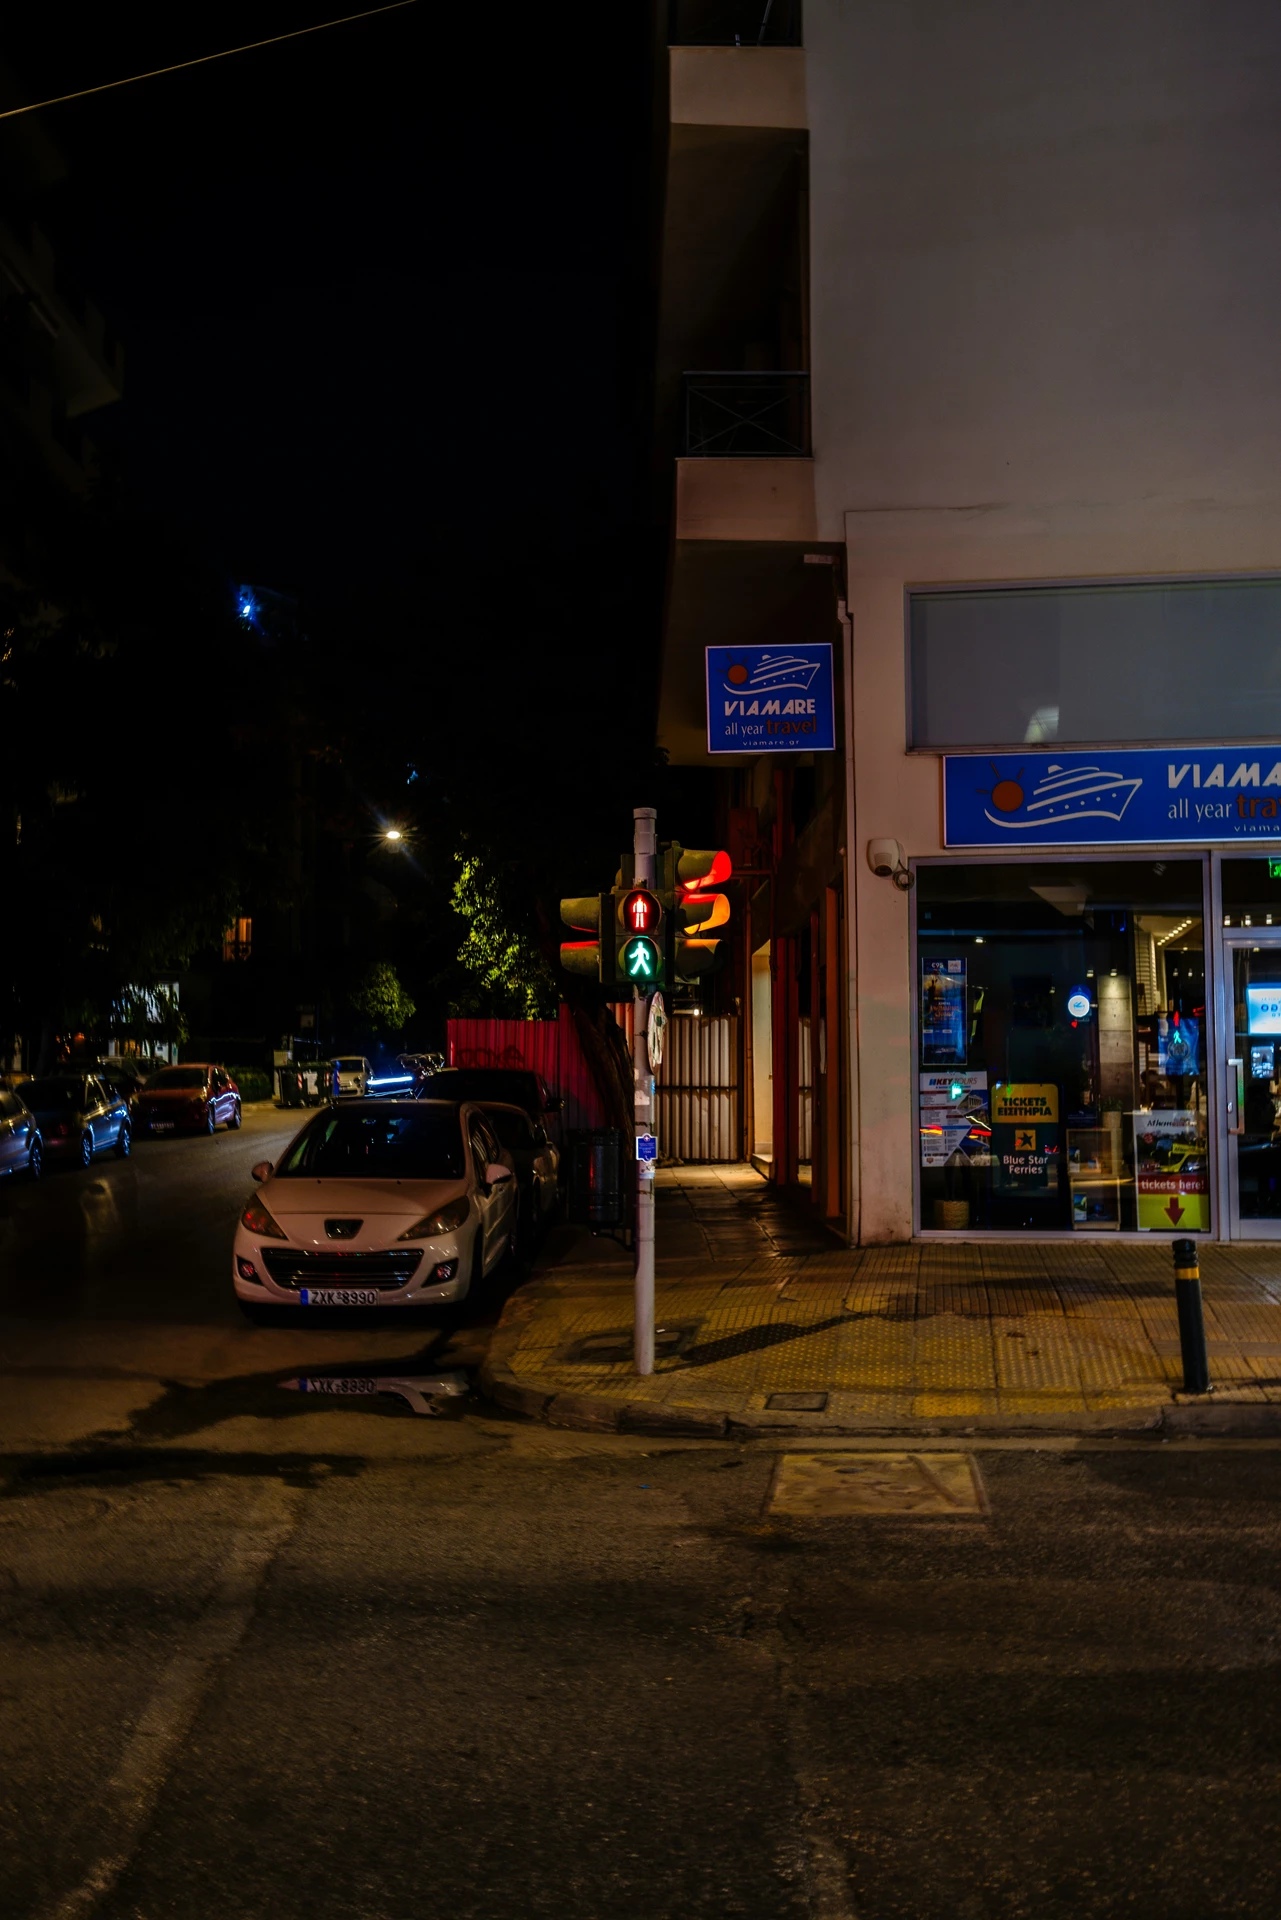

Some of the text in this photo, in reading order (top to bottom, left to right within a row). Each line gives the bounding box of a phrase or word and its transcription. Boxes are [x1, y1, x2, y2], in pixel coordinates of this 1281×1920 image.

[724, 698, 816, 717] VIAMARE
[724, 716, 817, 738] all year travel
[1168, 794, 1281, 823] all year tra
[937, 1078, 953, 1086] KEY
[1002, 1097, 1047, 1106] TICKETS
[1003, 1155, 1048, 1164] Blue Star
[1009, 1165, 1043, 1174] Ferries
[1141, 1180, 1205, 1190] tickets here!
